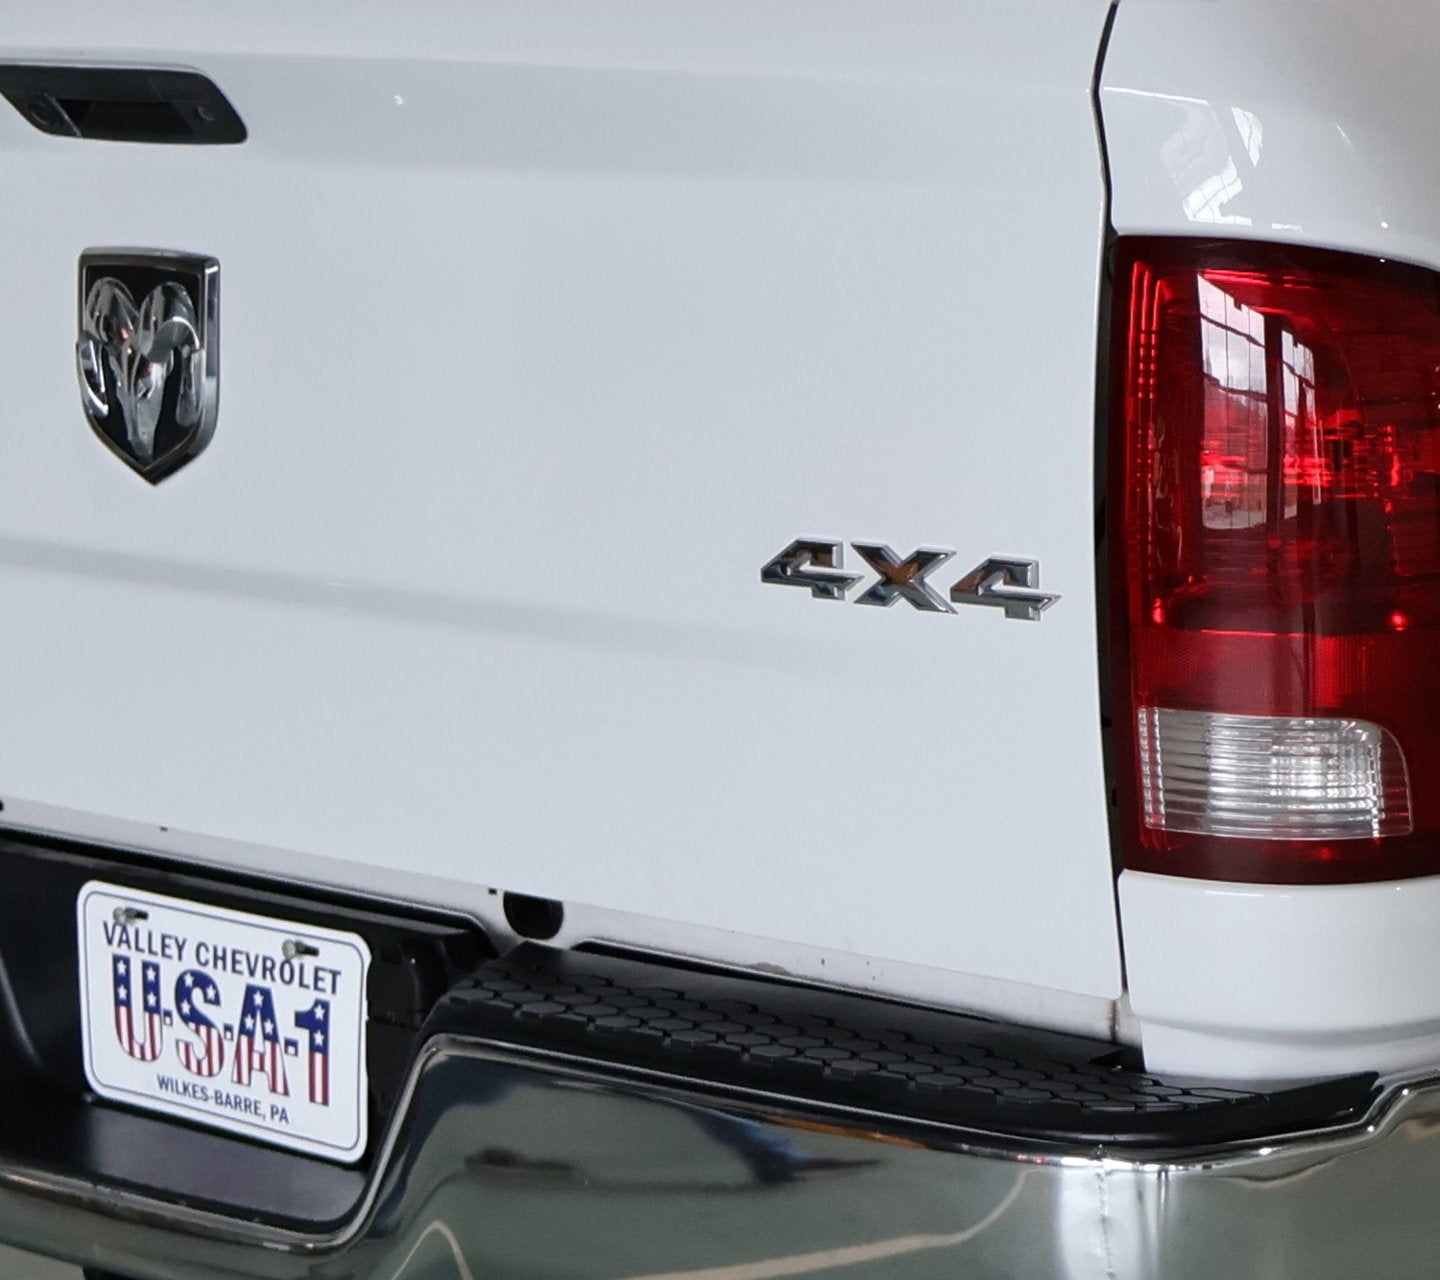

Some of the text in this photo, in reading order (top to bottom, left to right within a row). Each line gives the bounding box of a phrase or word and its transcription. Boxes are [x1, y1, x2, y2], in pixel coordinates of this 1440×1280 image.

[102, 920, 342, 996] VALLEY CHEVROLET
[156, 1073, 290, 1124] WILKES-BARRE, PA
